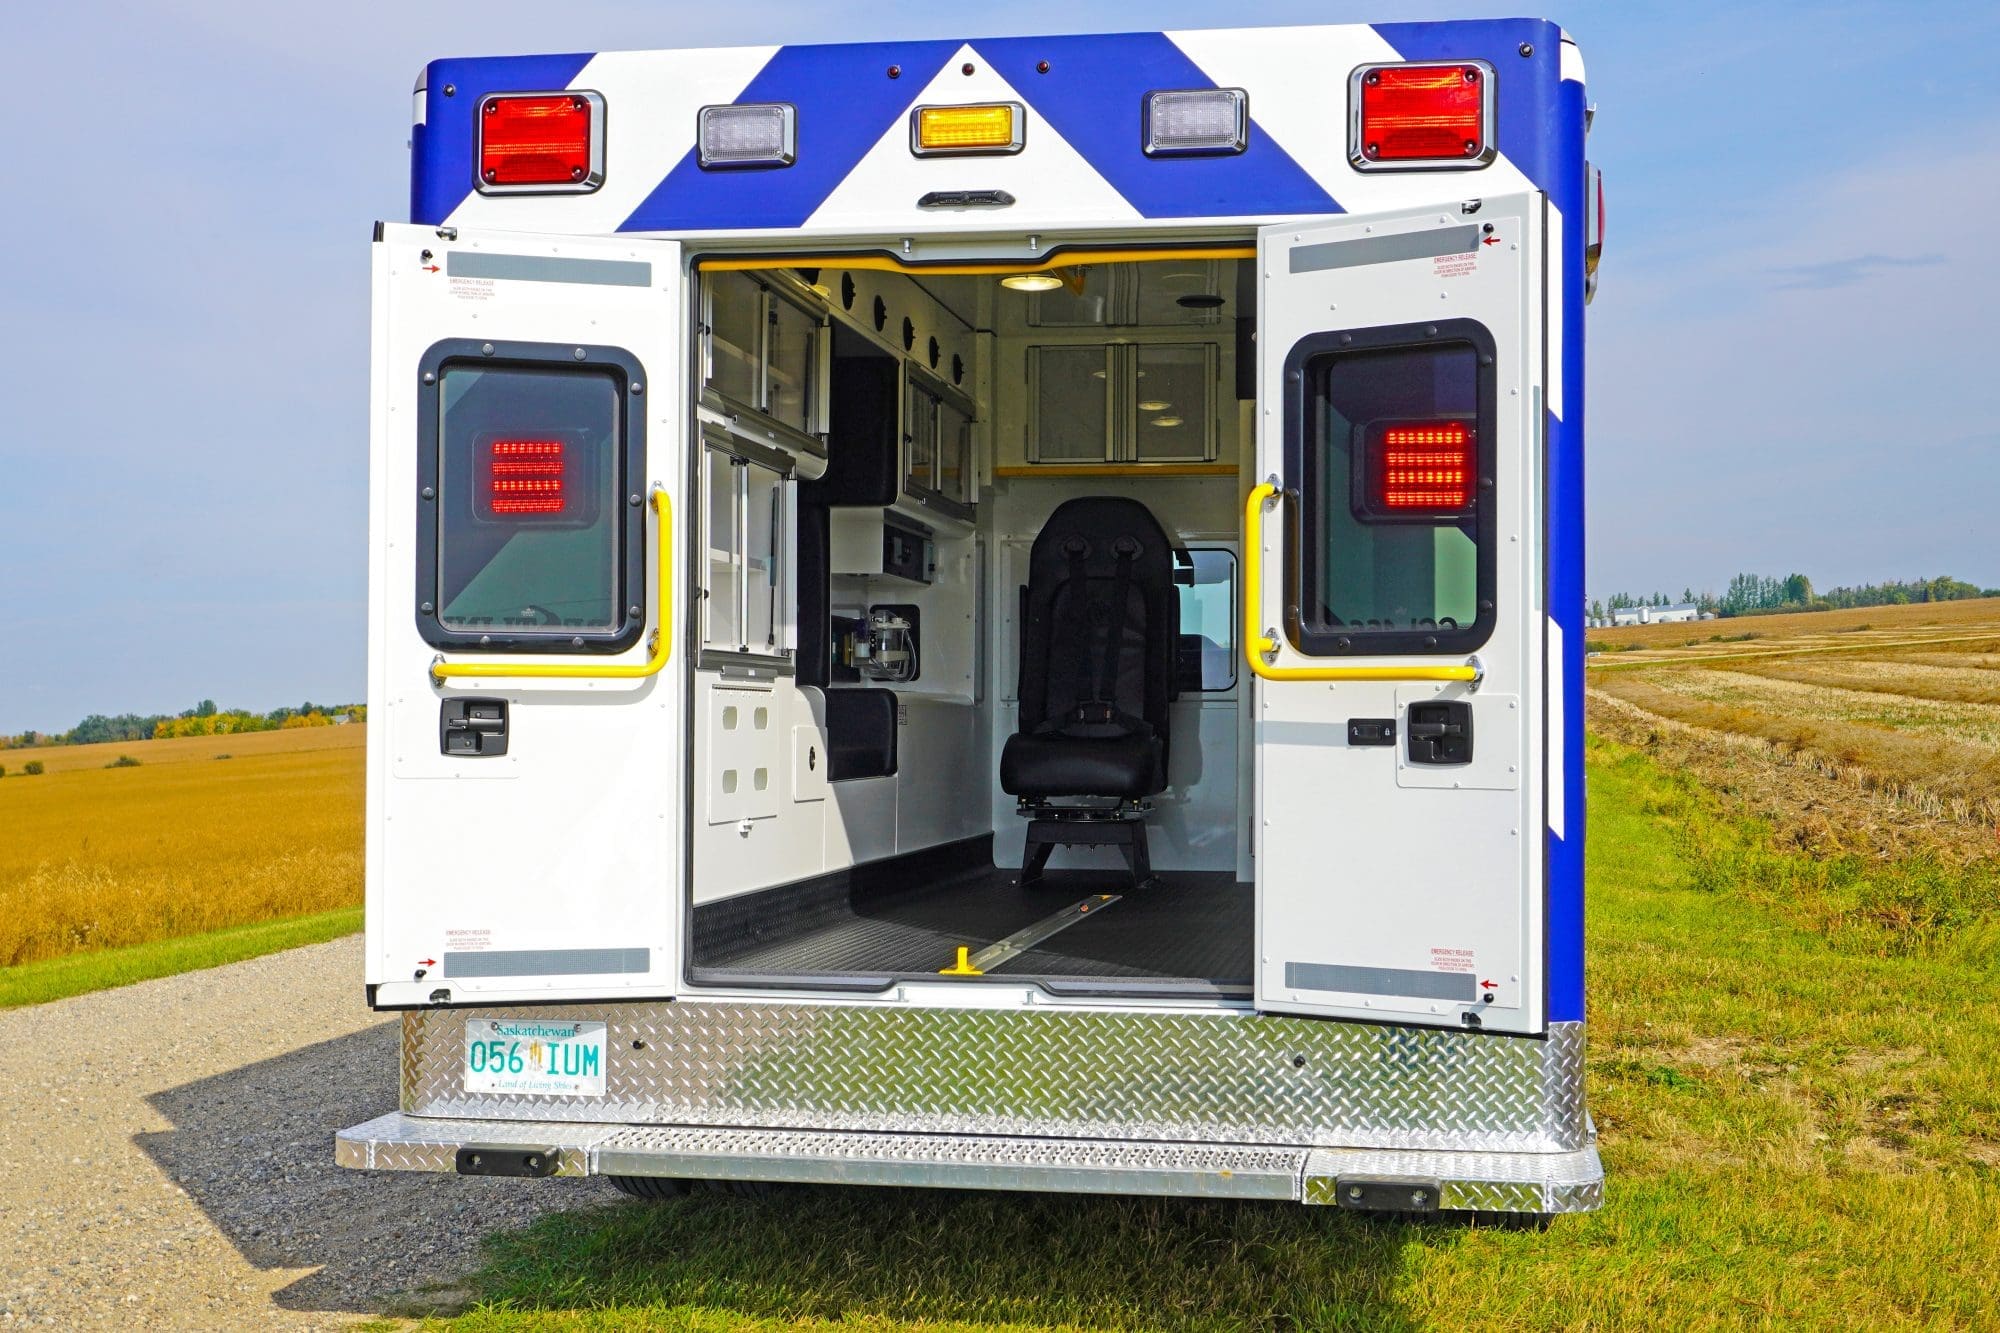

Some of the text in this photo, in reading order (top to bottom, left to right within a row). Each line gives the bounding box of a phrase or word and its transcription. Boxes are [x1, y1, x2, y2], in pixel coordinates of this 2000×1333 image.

[497, 1024, 575, 1037] Saskatchewan
[470, 1041, 599, 1076] 056 IUM
